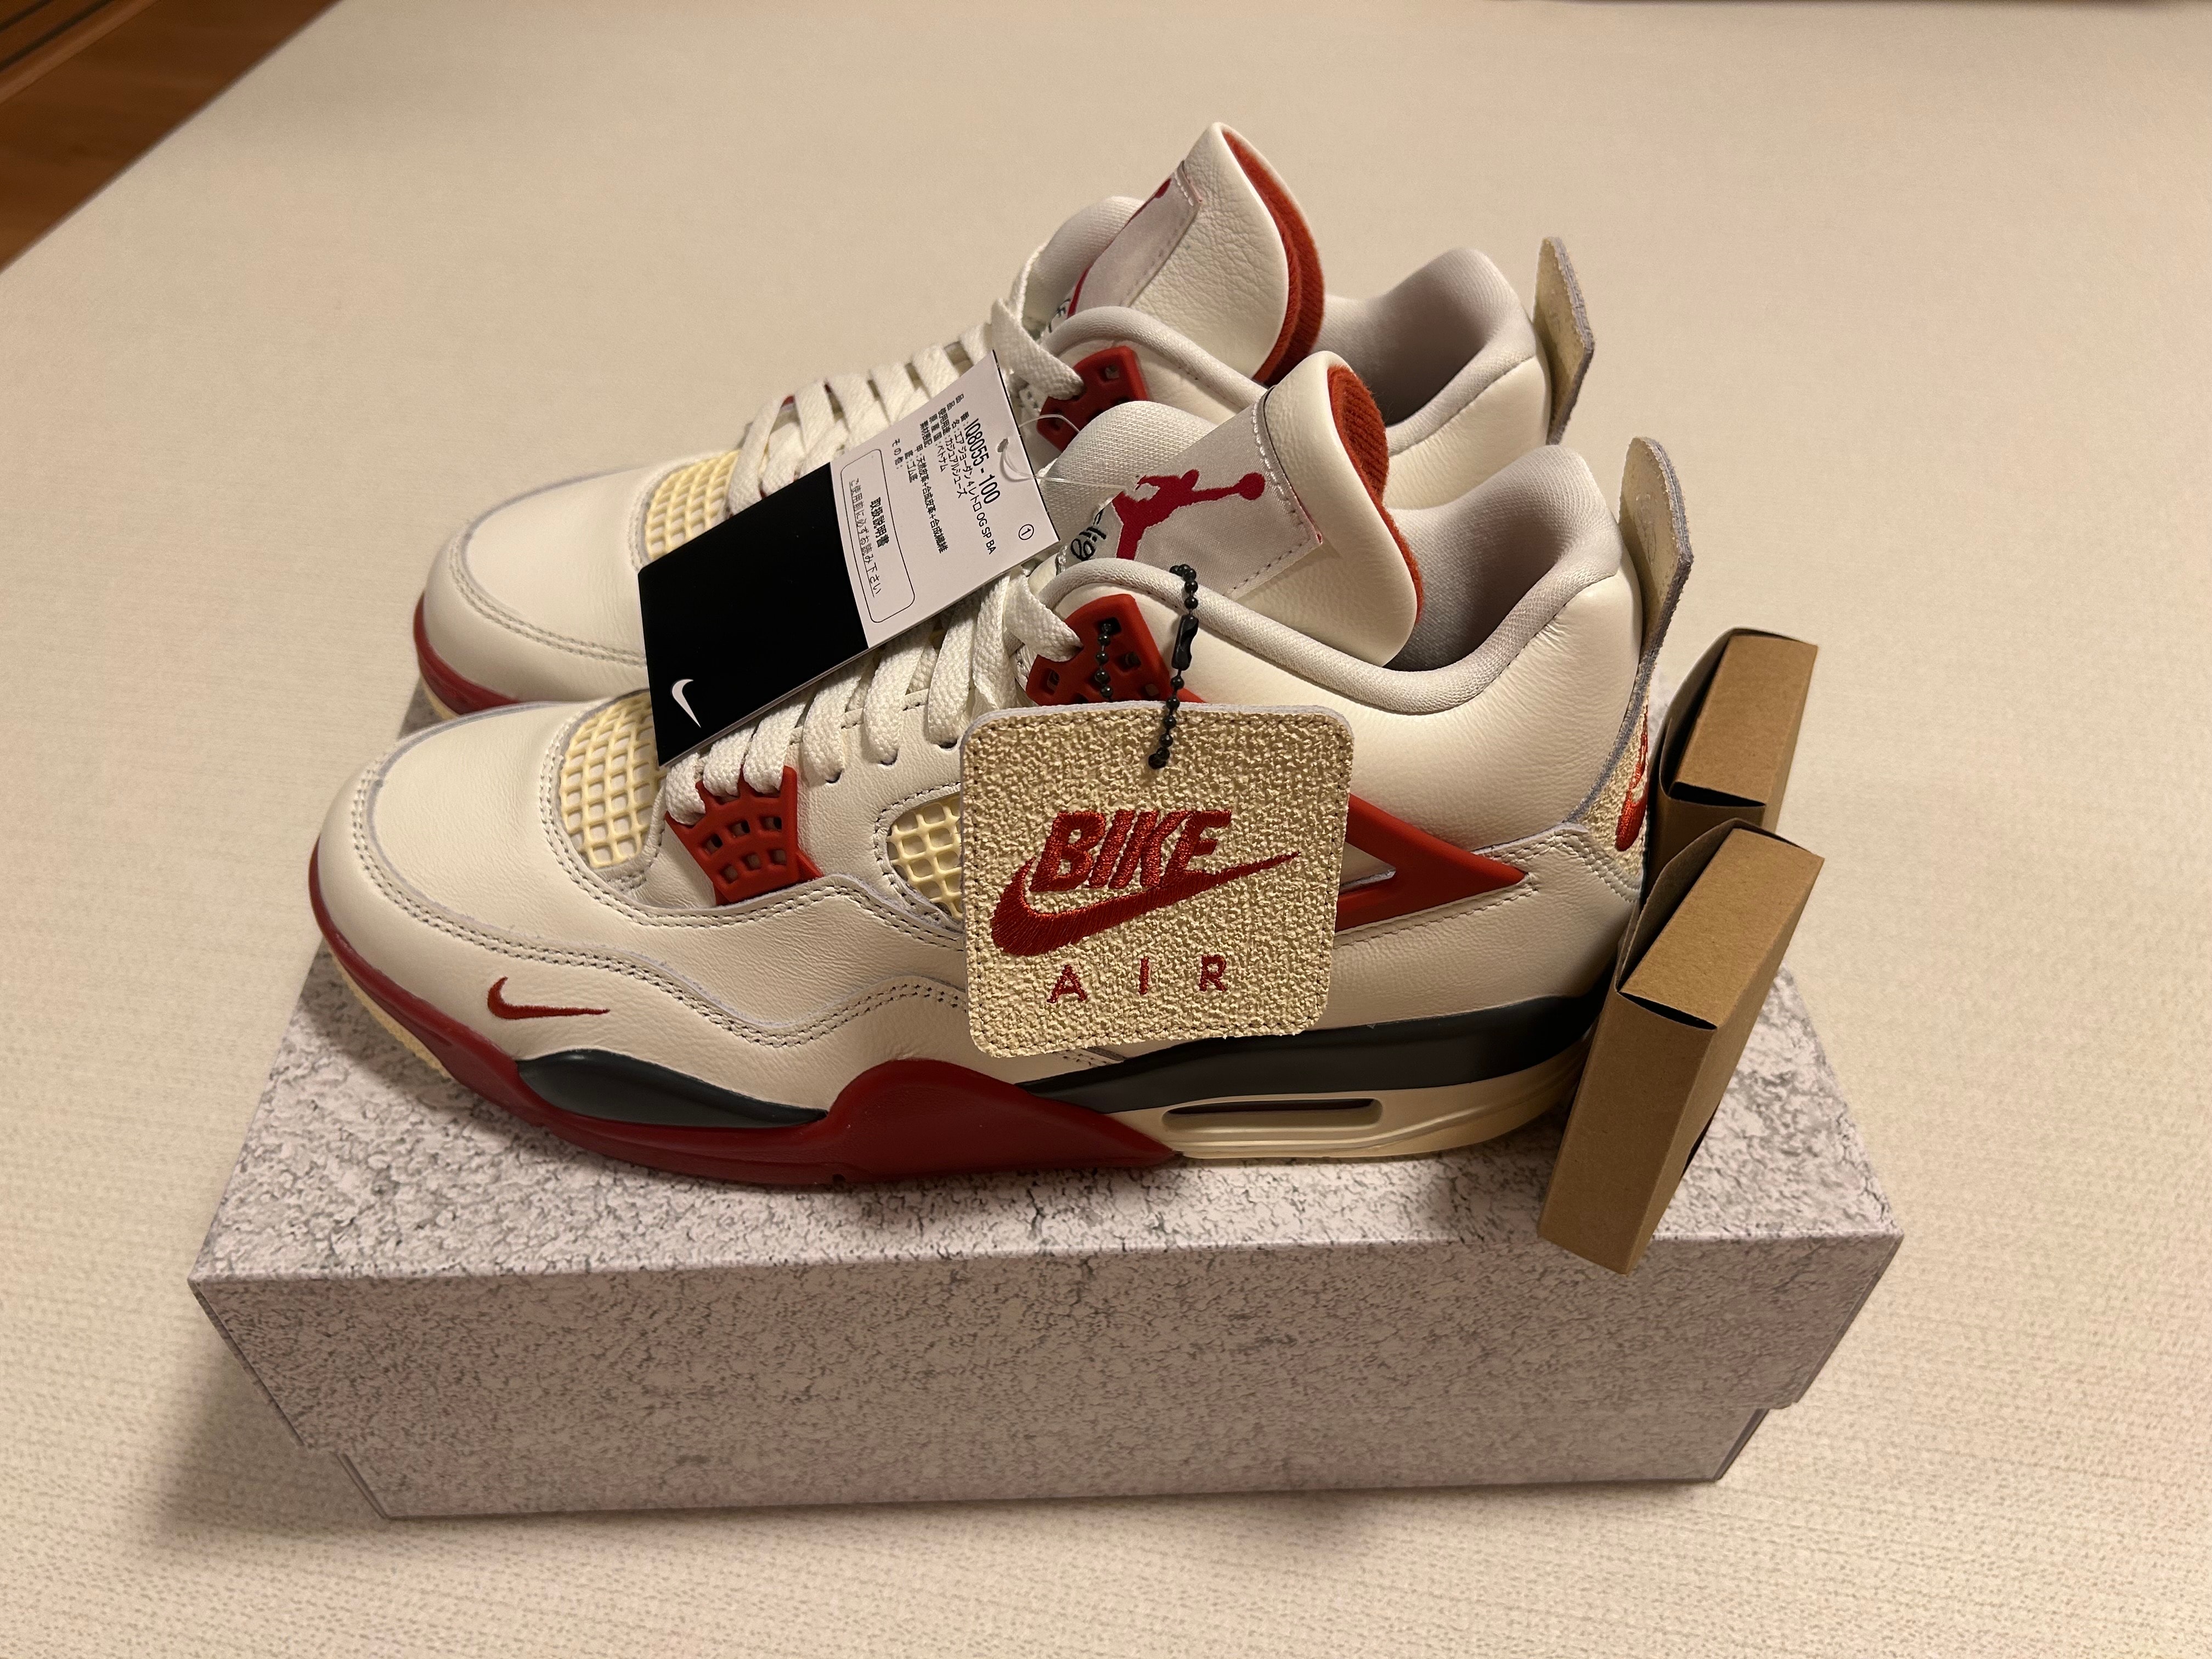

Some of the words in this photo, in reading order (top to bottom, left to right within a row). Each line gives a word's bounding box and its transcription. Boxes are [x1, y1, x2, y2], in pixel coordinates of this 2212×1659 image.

[963, 417, 990, 467] IQ8055
[978, 473, 1001, 505] 100
[850, 478, 882, 595] ご使用前に必ずお読み下さい
[870, 496, 890, 548] 取扱説明書
[976, 512, 988, 528] OG
[981, 526, 992, 539] SP
[985, 539, 997, 555] BA
[1029, 810, 1232, 892] BIKE
